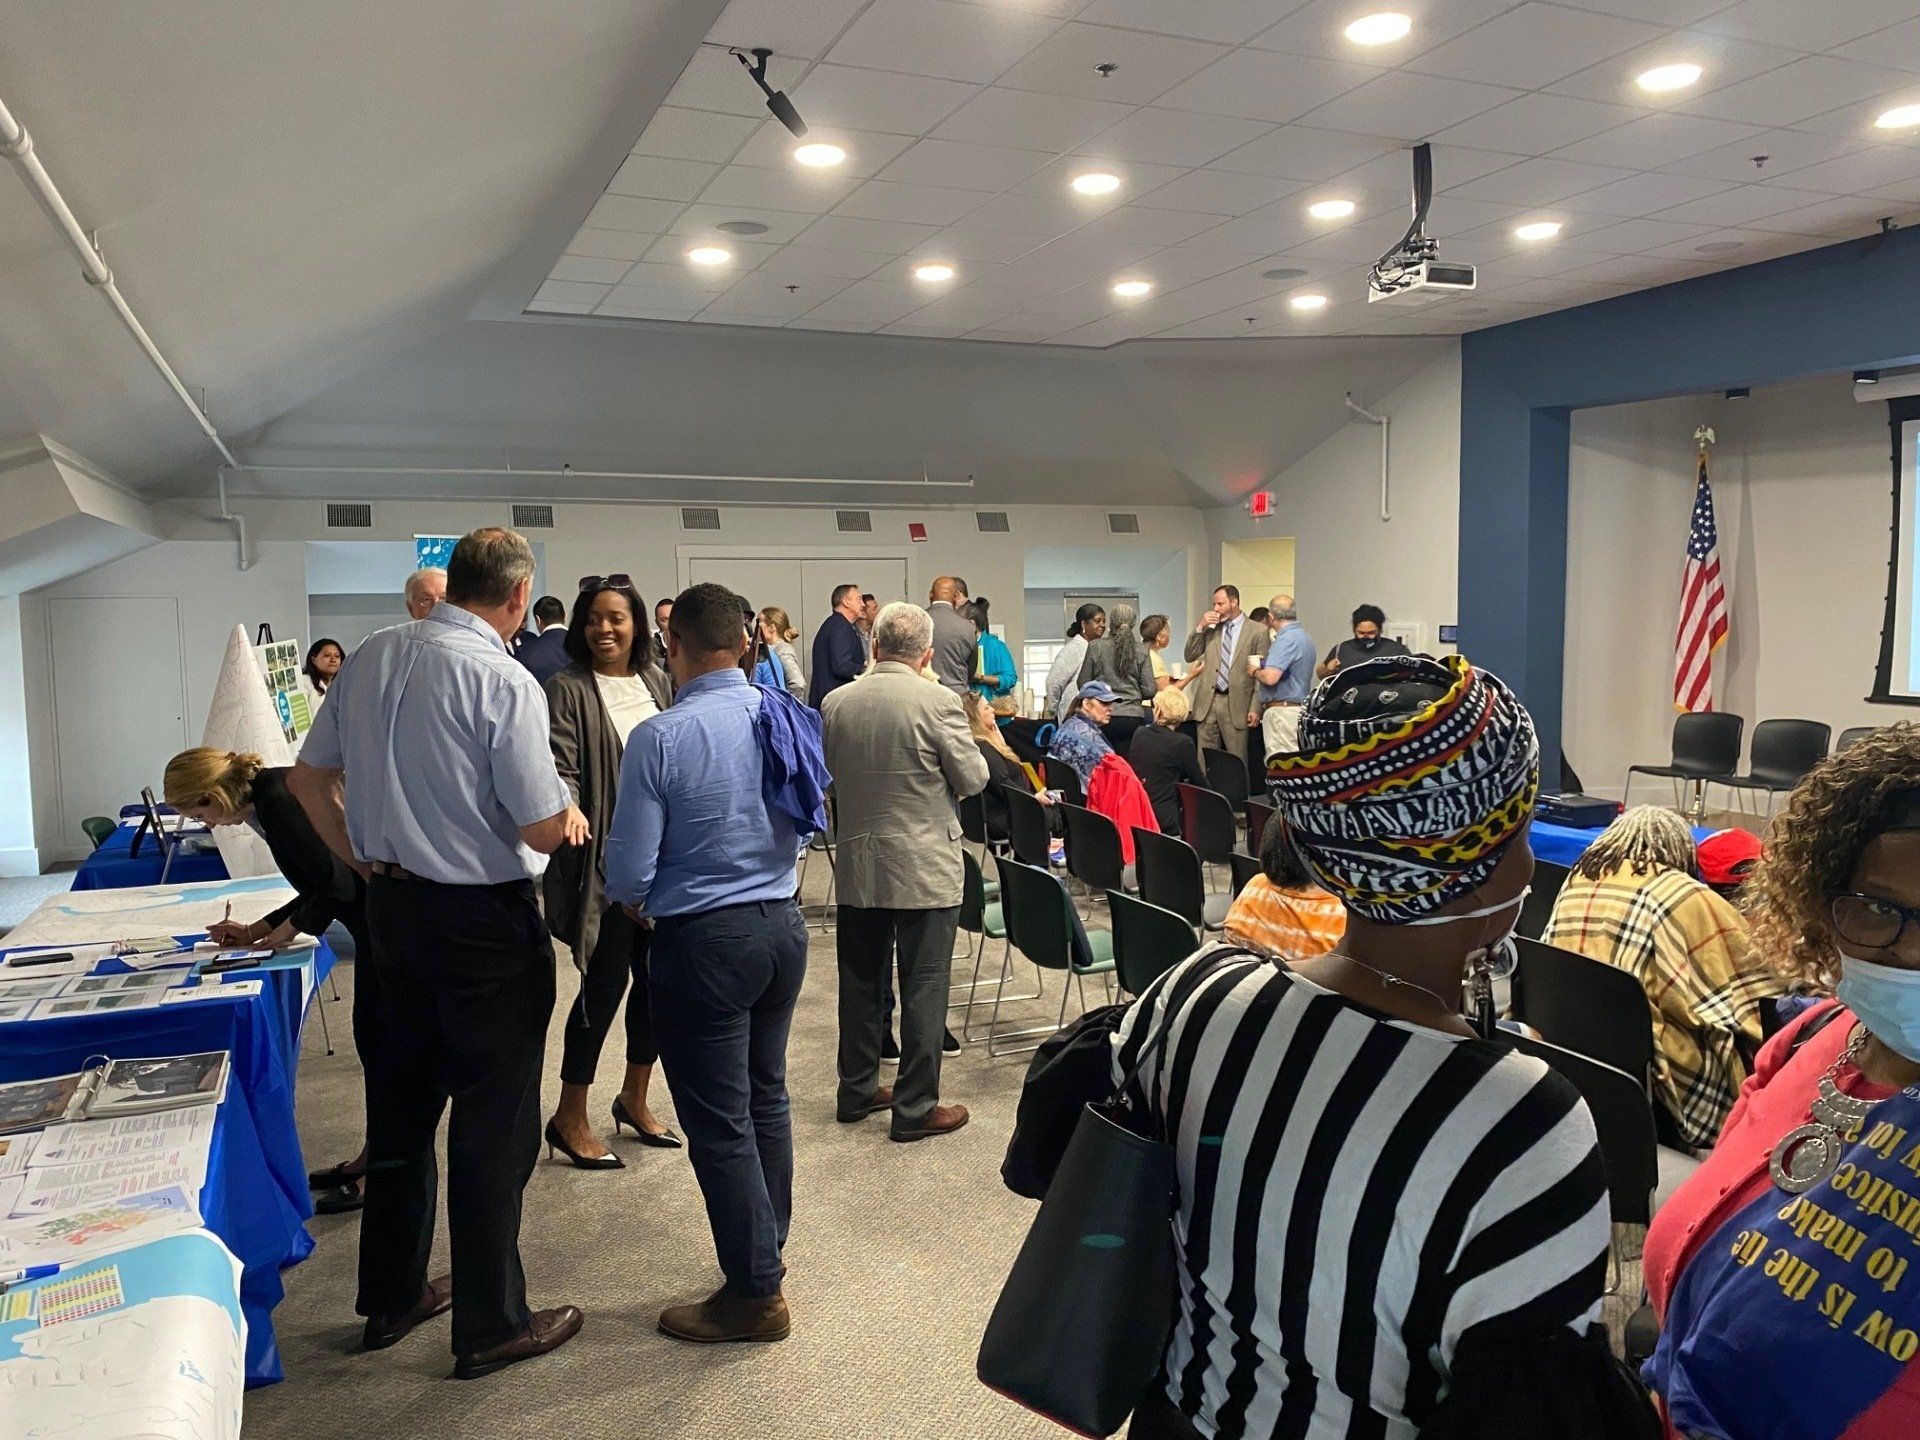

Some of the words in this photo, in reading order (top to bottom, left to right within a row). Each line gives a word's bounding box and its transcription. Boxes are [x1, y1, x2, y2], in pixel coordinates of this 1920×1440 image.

[1777, 1196, 1868, 1263] make
[1764, 1248, 1820, 1301] the
[1866, 1247, 1909, 1292] to
[1818, 1283, 1857, 1328] is
[1854, 1310, 1918, 1361] ow
